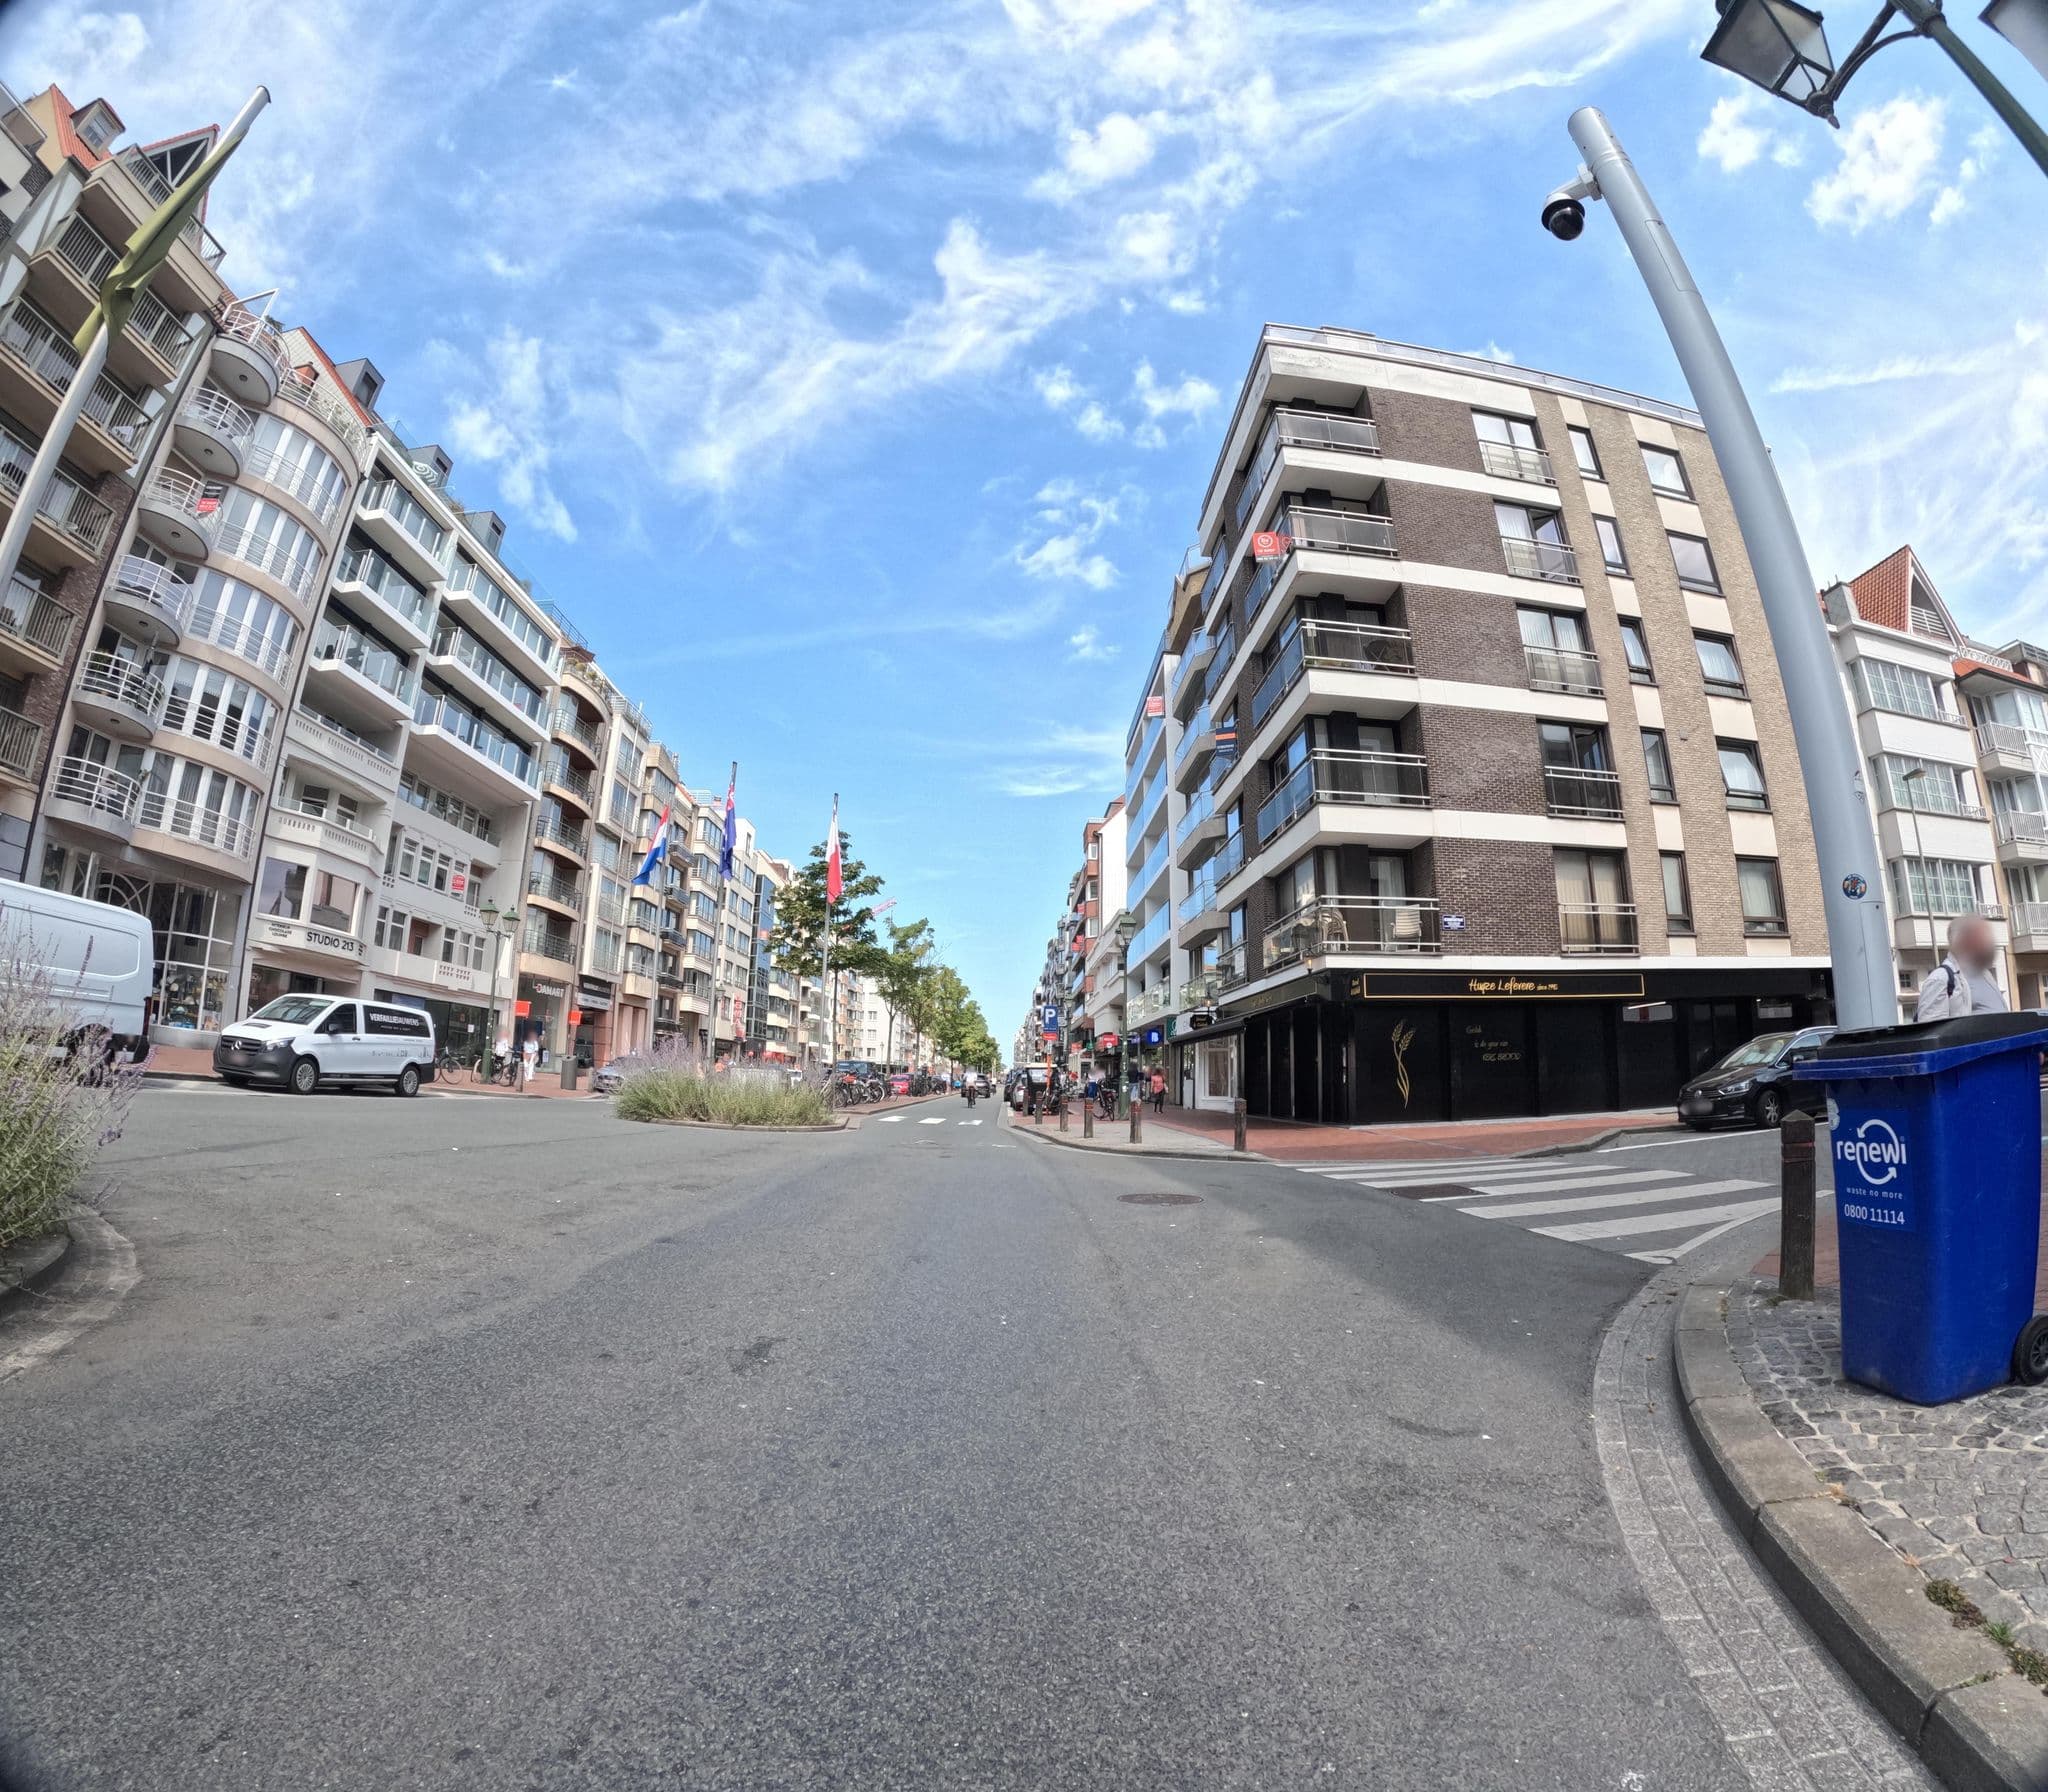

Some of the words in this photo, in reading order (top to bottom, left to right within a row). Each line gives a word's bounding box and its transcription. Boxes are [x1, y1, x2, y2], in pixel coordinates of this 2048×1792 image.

[306, 931, 340, 948] STUDIO
[341, 940, 354, 952] 213
[537, 983, 565, 998] DAMART
[1045, 1008, 1056, 1025] P
[1836, 1140, 1907, 1165] renewi
[1846, 1186, 1867, 1197] waste
[1869, 1189, 1879, 1198] no
[1881, 1190, 1904, 1200] more
[1844, 1203, 1868, 1220] 0800
[1870, 1208, 1905, 1225] 11114
